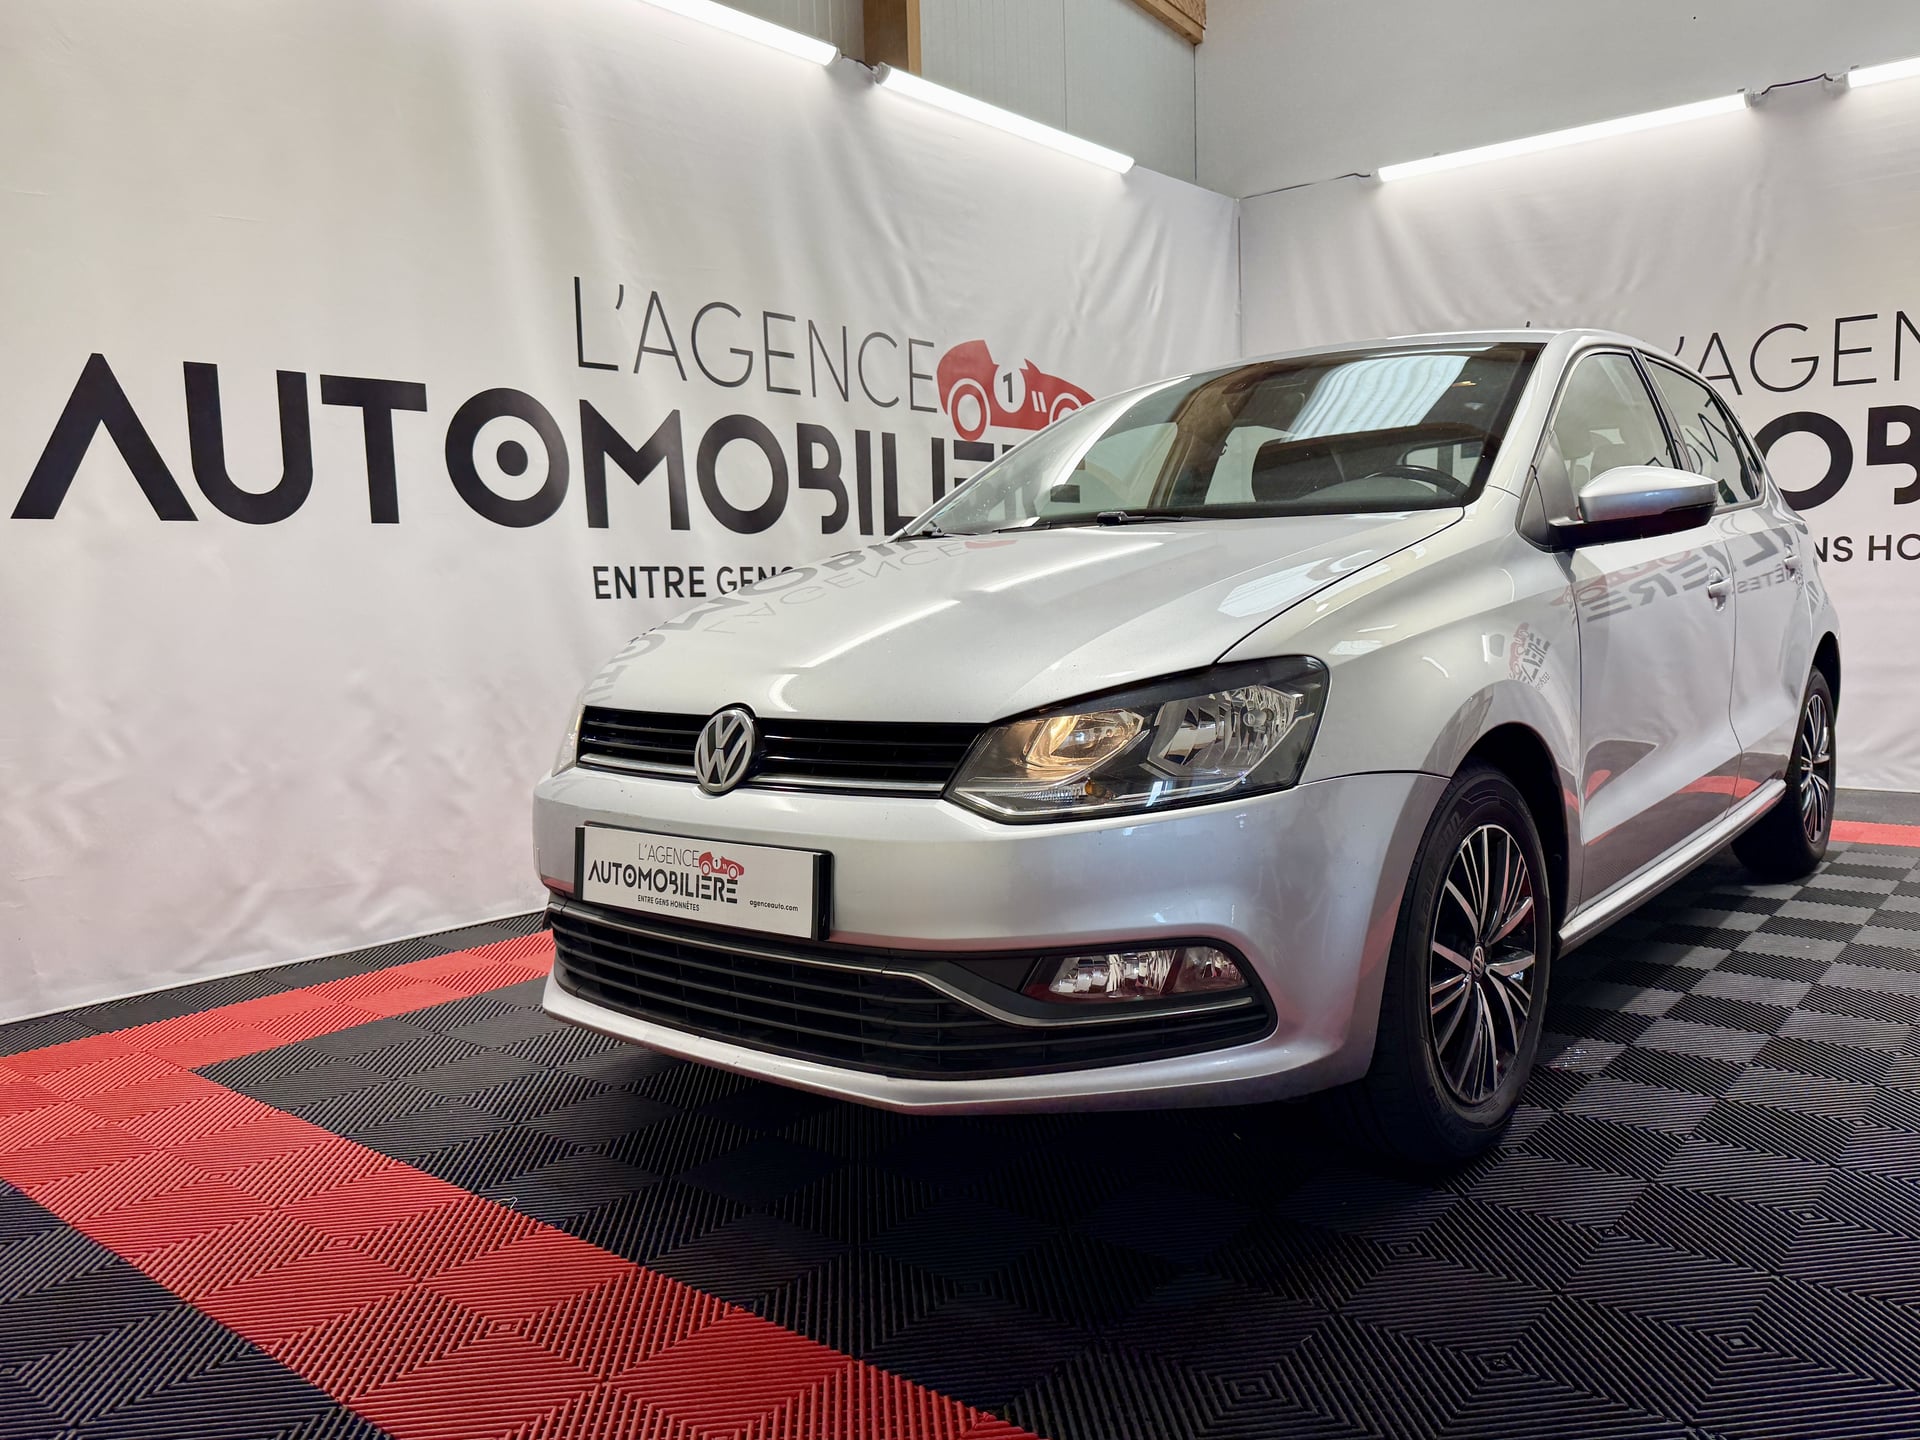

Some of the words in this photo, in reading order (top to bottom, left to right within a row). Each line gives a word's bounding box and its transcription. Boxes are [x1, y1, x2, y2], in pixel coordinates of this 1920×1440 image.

[574, 276, 938, 414] L'AGENCE
[593, 566, 706, 599] ENTRE
[638, 843, 700, 868] L'AGENCE
[588, 859, 739, 905] AUTOMOBILIERE
[637, 894, 654, 904] ENTRE
[655, 897, 669, 906] GENS
[670, 900, 700, 911] HONNÊTES
[749, 900, 799, 912] agenceauto.com
